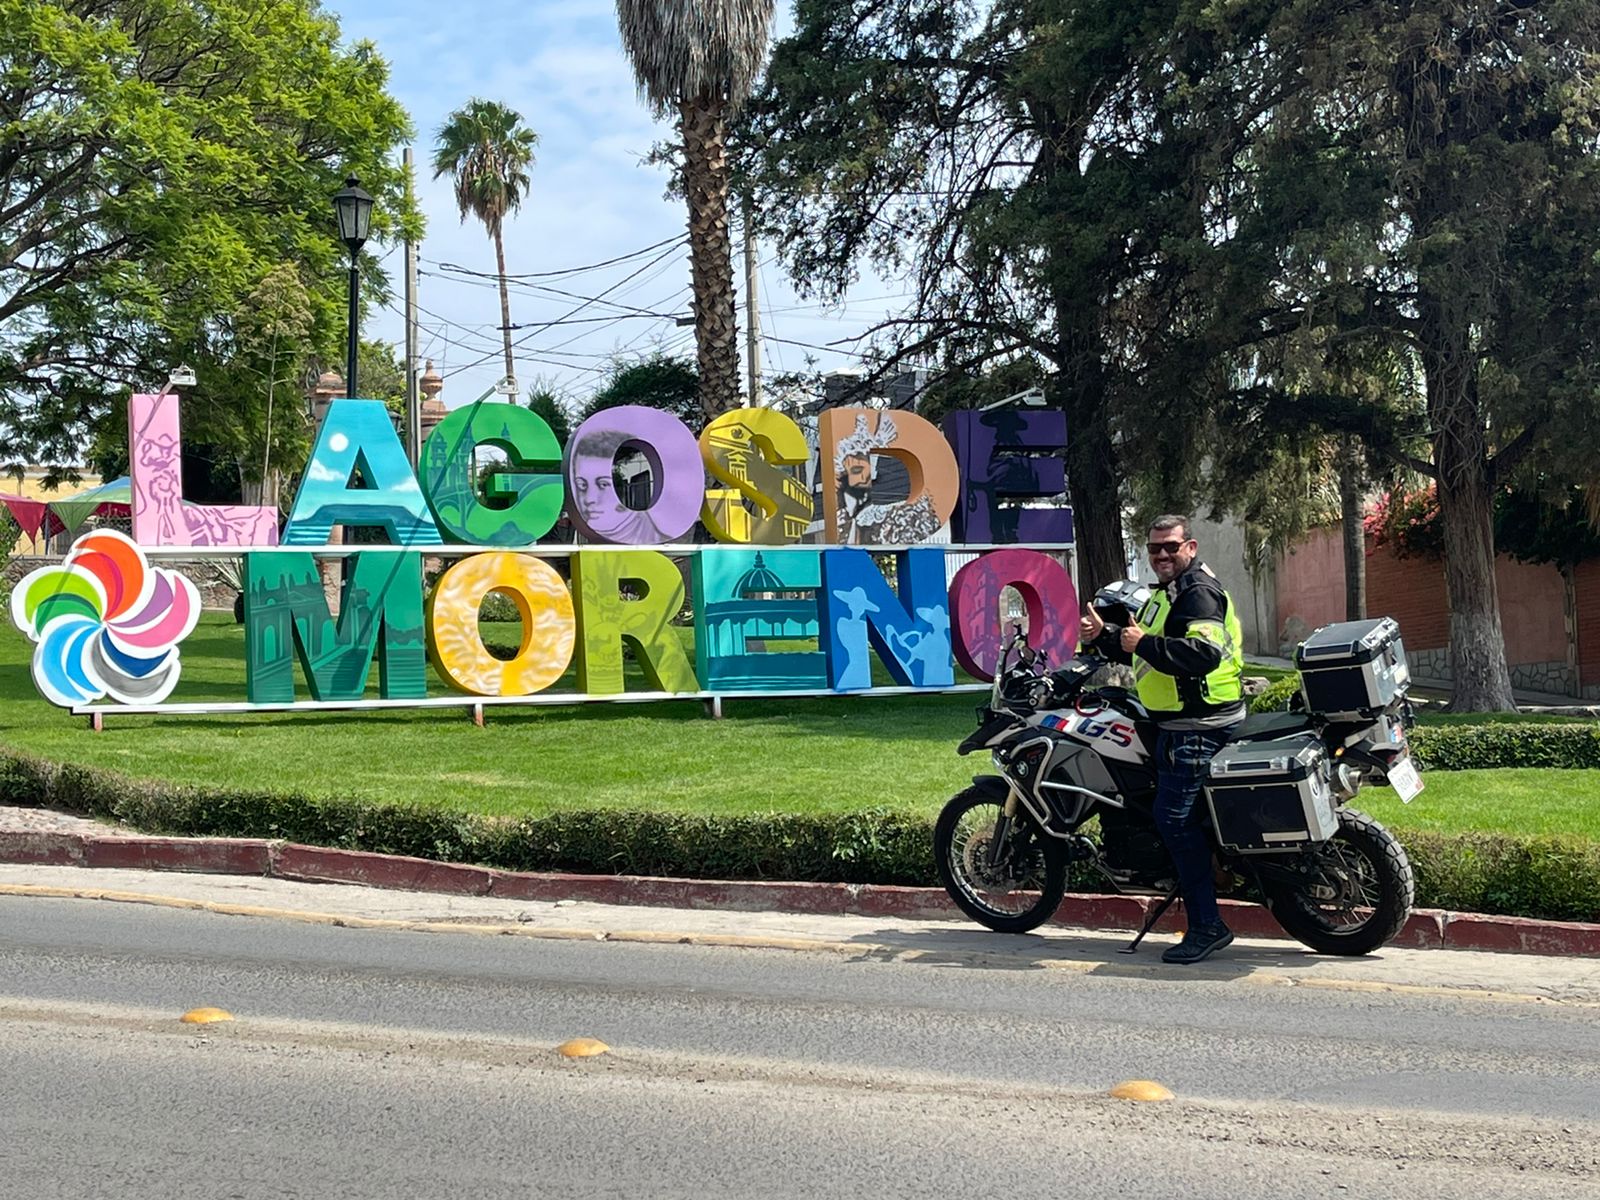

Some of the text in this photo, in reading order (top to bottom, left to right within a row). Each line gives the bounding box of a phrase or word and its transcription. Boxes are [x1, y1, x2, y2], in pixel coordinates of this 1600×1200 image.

[128, 394, 1073, 546] LAGOS DE
[244, 548, 1079, 701] MORENO
[1076, 718, 1136, 747] GS
